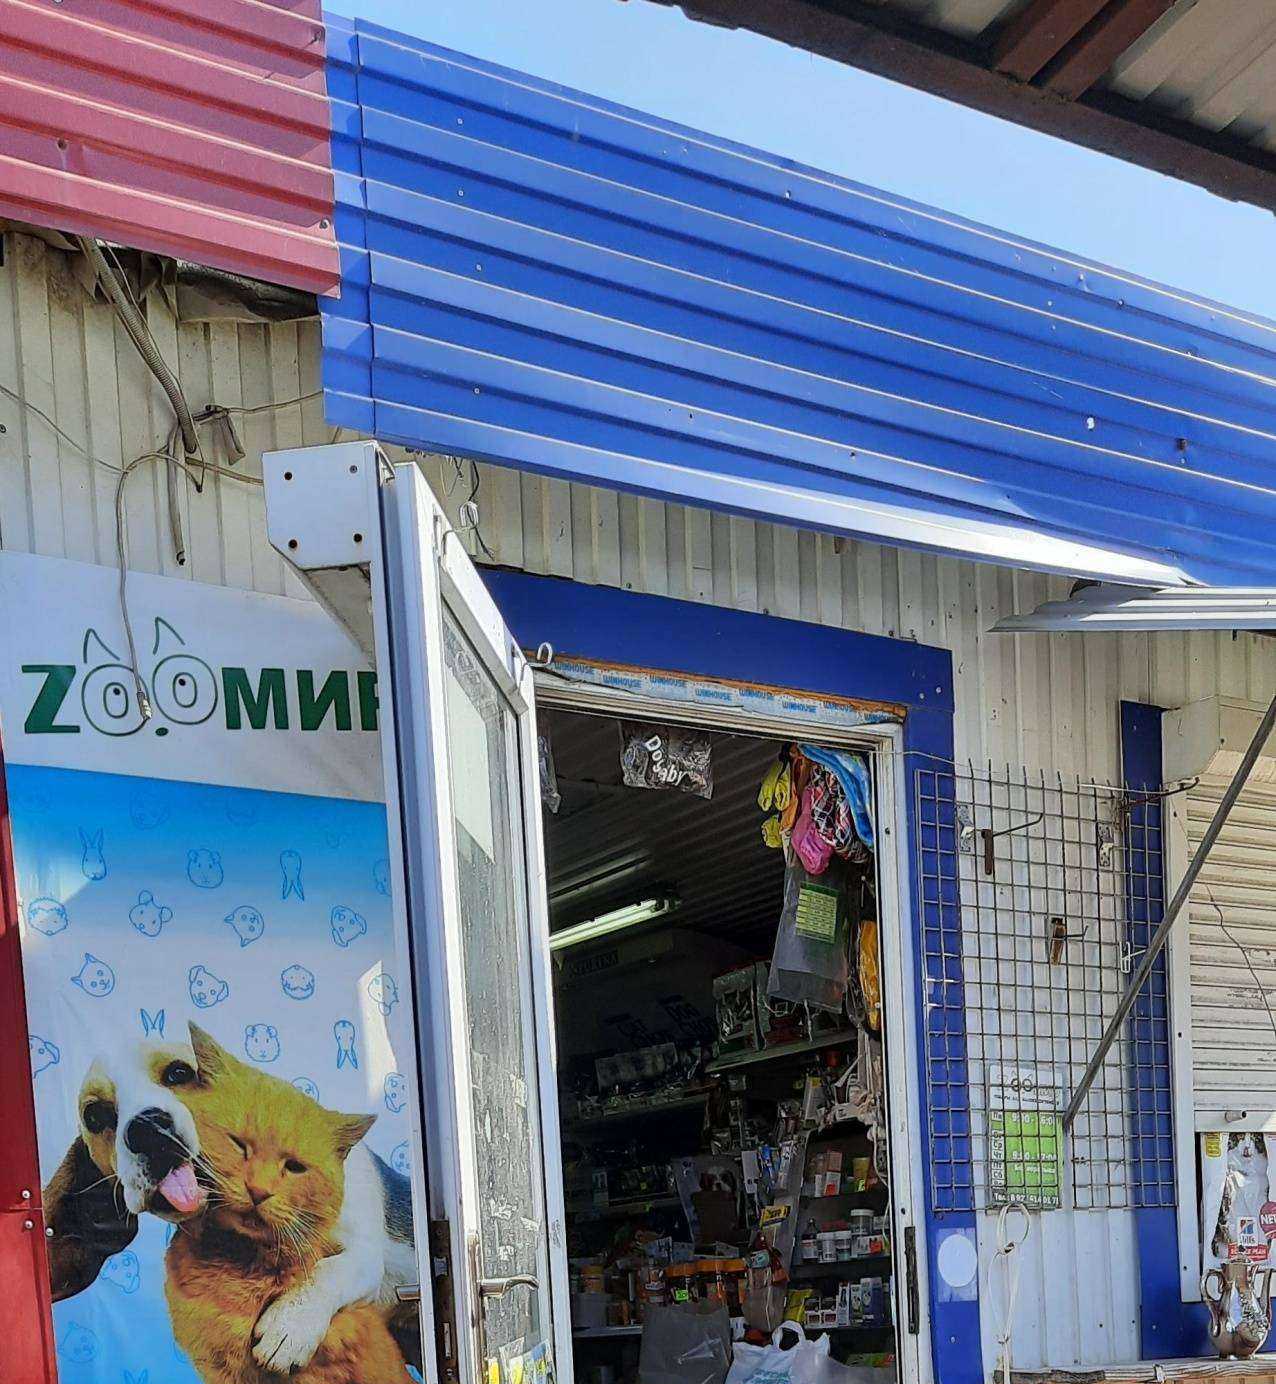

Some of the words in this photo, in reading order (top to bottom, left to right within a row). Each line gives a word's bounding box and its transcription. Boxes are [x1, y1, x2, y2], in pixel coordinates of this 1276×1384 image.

[602, 674, 641, 688] WINHOUSE
[695, 687, 731, 701] WINHOUSE
[781, 700, 817, 713] WINHOUSE
